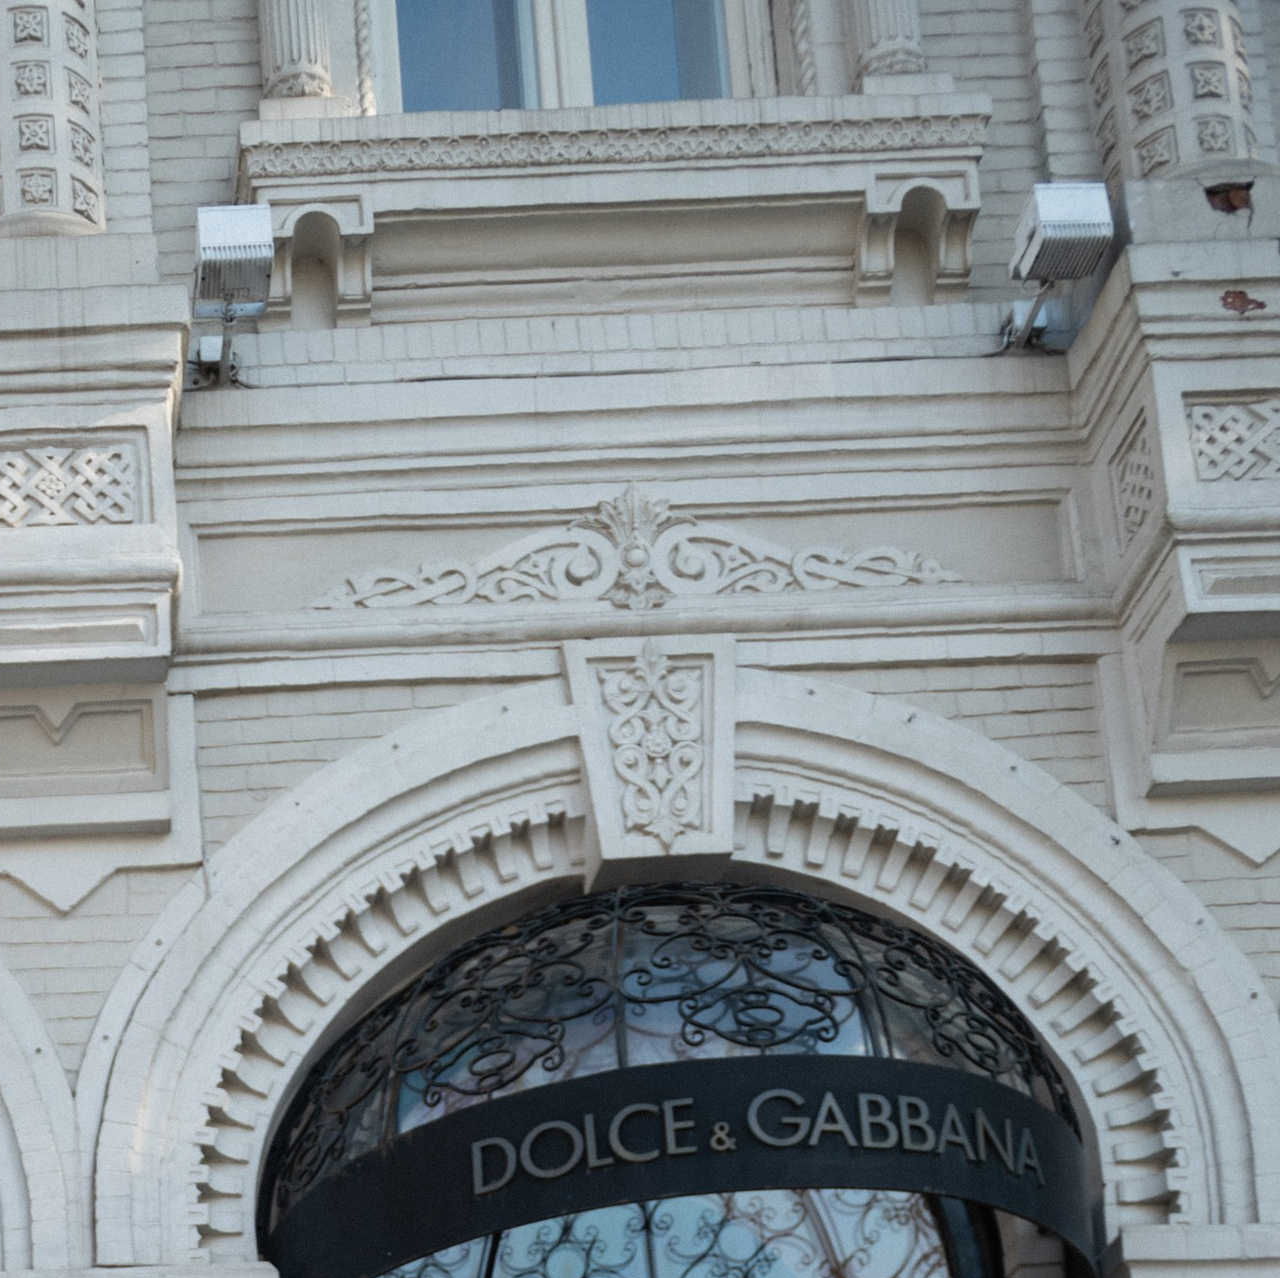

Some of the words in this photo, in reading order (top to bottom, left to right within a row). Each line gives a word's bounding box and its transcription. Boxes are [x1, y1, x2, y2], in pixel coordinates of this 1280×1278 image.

[471, 1098, 698, 1195] DOLCE
[710, 1121, 737, 1152] &
[746, 1088, 1046, 1186] GABBANA
